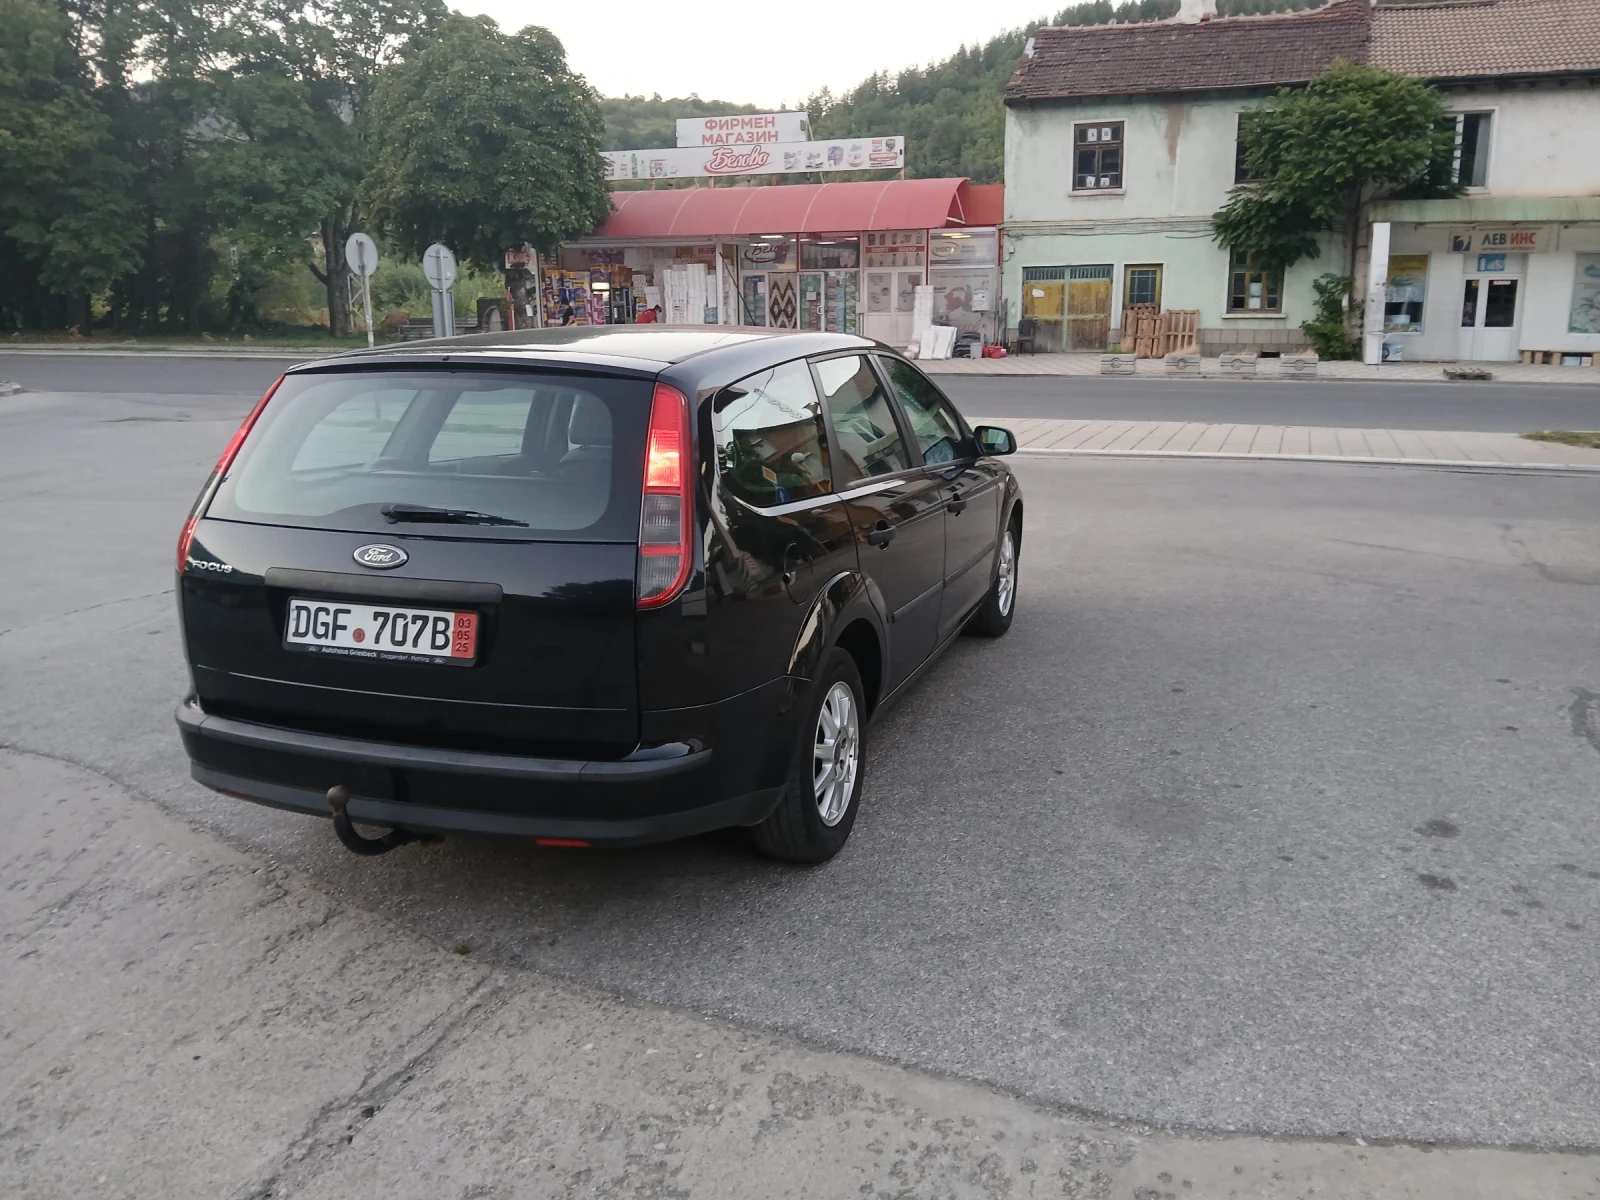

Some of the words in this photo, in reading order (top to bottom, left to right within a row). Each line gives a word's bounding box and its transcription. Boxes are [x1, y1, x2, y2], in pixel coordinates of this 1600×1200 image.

[704, 116, 776, 132] ФИРМЕН
[701, 129, 779, 145] МАГАЗИН
[1481, 233, 1508, 246] ЛЕВ
[1509, 231, 1537, 245] ИНС
[363, 547, 394, 562] Ford
[192, 559, 233, 574] FOCUS
[292, 604, 352, 641] DGF
[372, 611, 451, 651] 707B
[457, 617, 471, 629] 03
[456, 629, 470, 641] 05
[321, 646, 349, 655] Autohaus
[455, 641, 469, 652] 25
